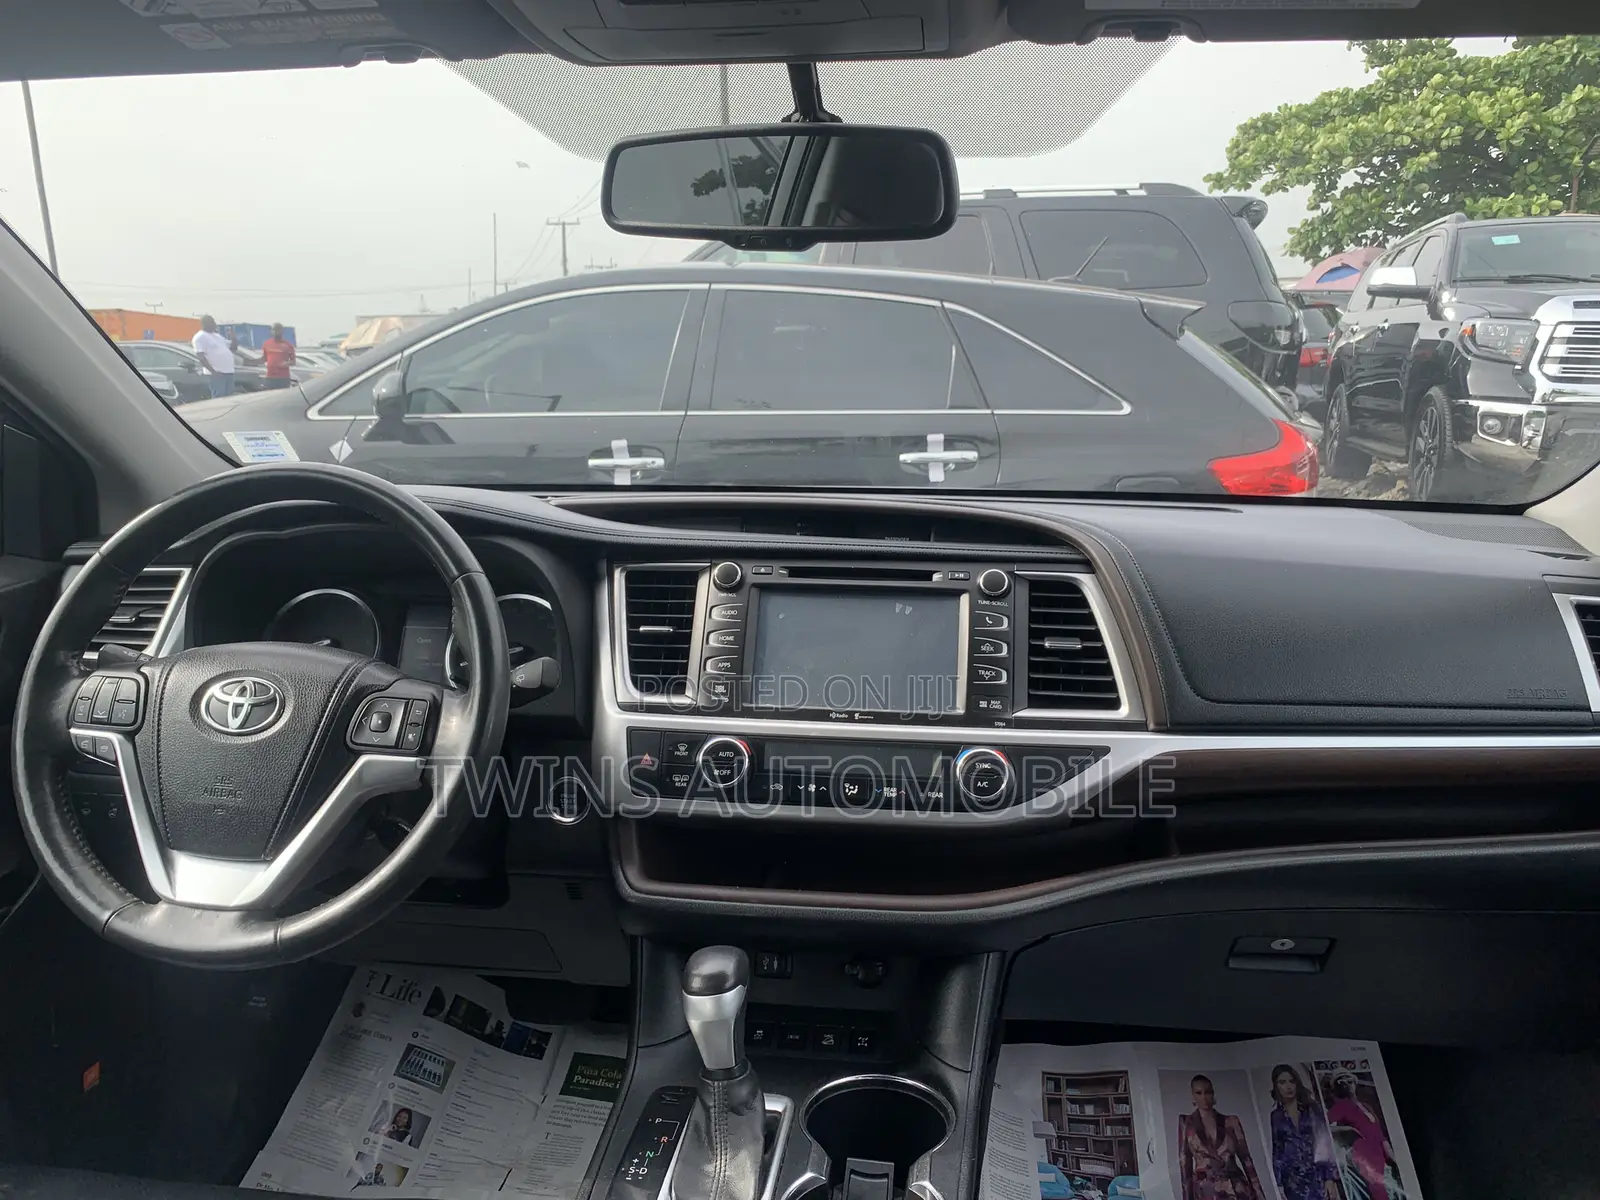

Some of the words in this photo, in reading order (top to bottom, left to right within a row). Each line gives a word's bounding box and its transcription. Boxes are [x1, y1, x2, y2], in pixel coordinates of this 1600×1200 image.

[980, 645, 995, 653] SEEK
[978, 669, 996, 677] TRACK
[201, 787, 243, 799] AIRBAG
[376, 972, 422, 1005] Life
[573, 1075, 614, 1089] Paradise
[645, 1150, 655, 1158] N
